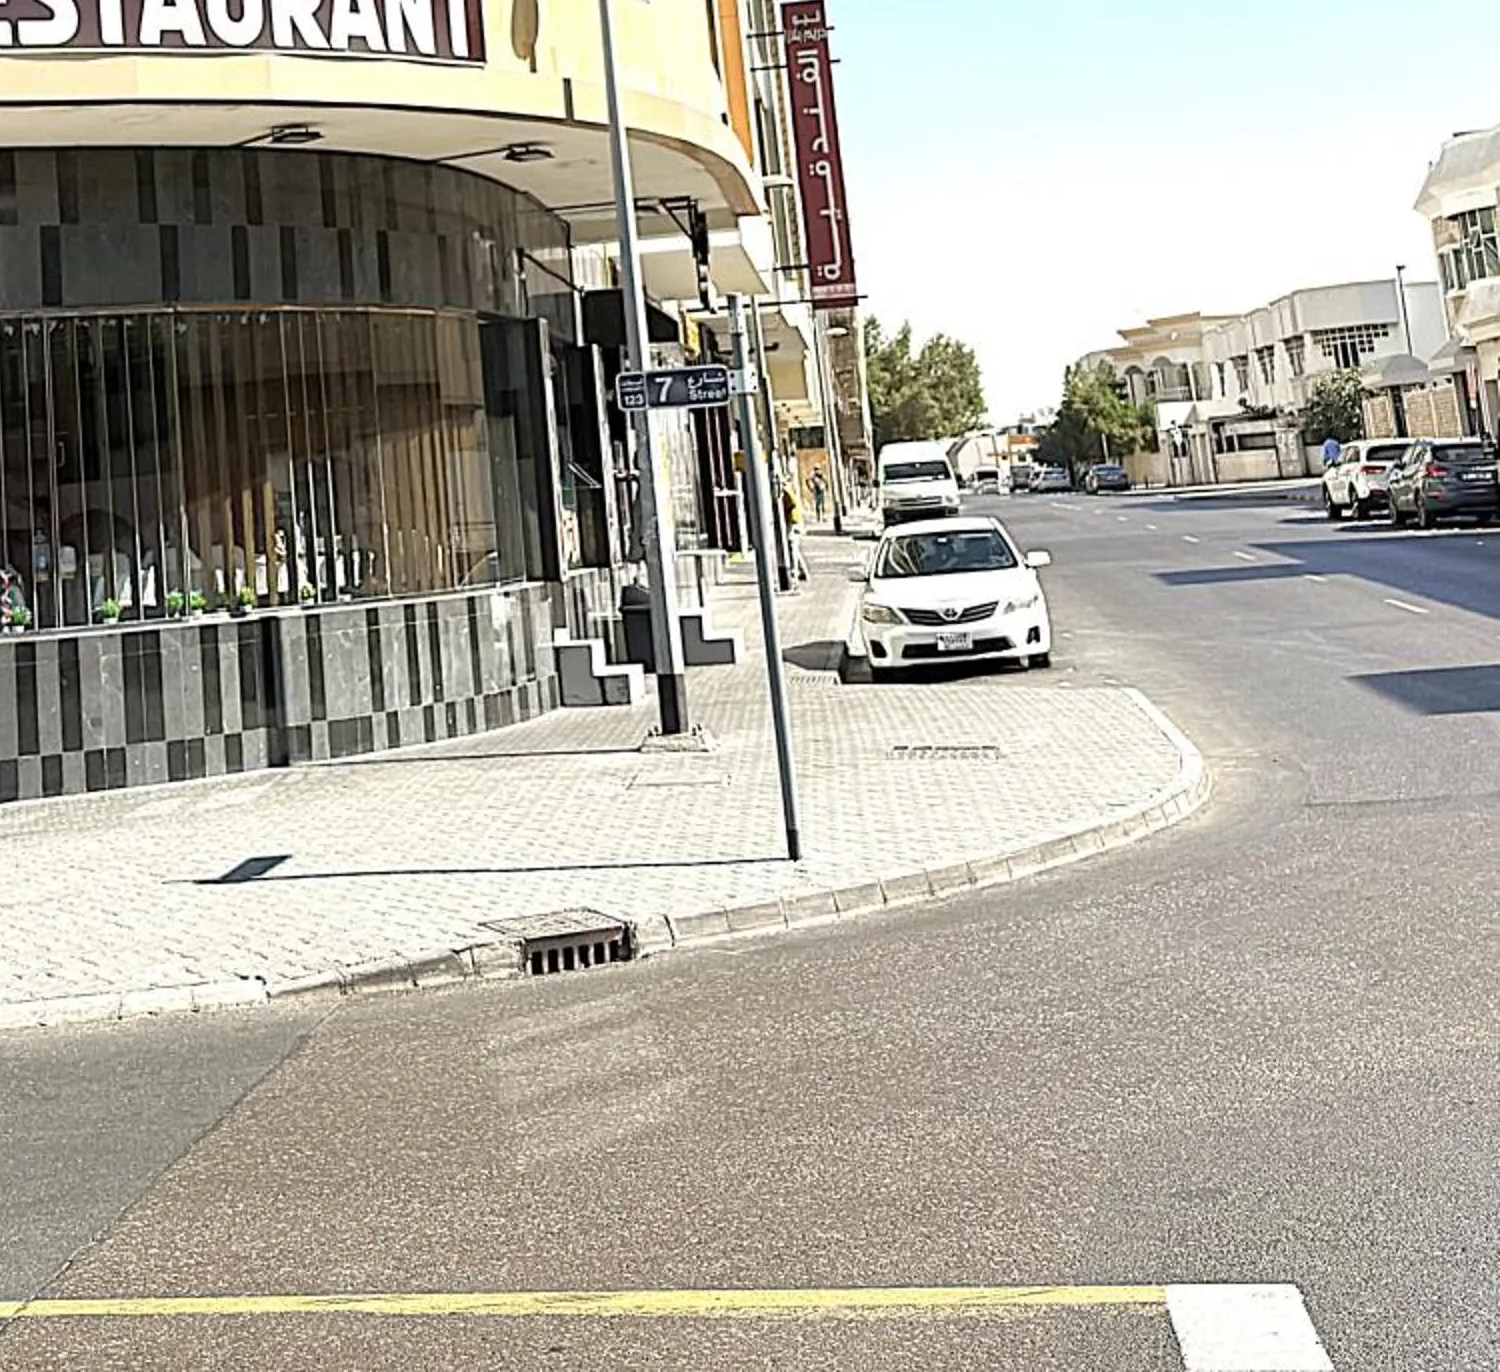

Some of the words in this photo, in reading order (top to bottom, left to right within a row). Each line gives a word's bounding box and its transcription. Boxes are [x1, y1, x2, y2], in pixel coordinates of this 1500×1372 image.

[655, 377, 673, 403] 7
[689, 388, 726, 400] Street
[624, 394, 644, 406] 123
